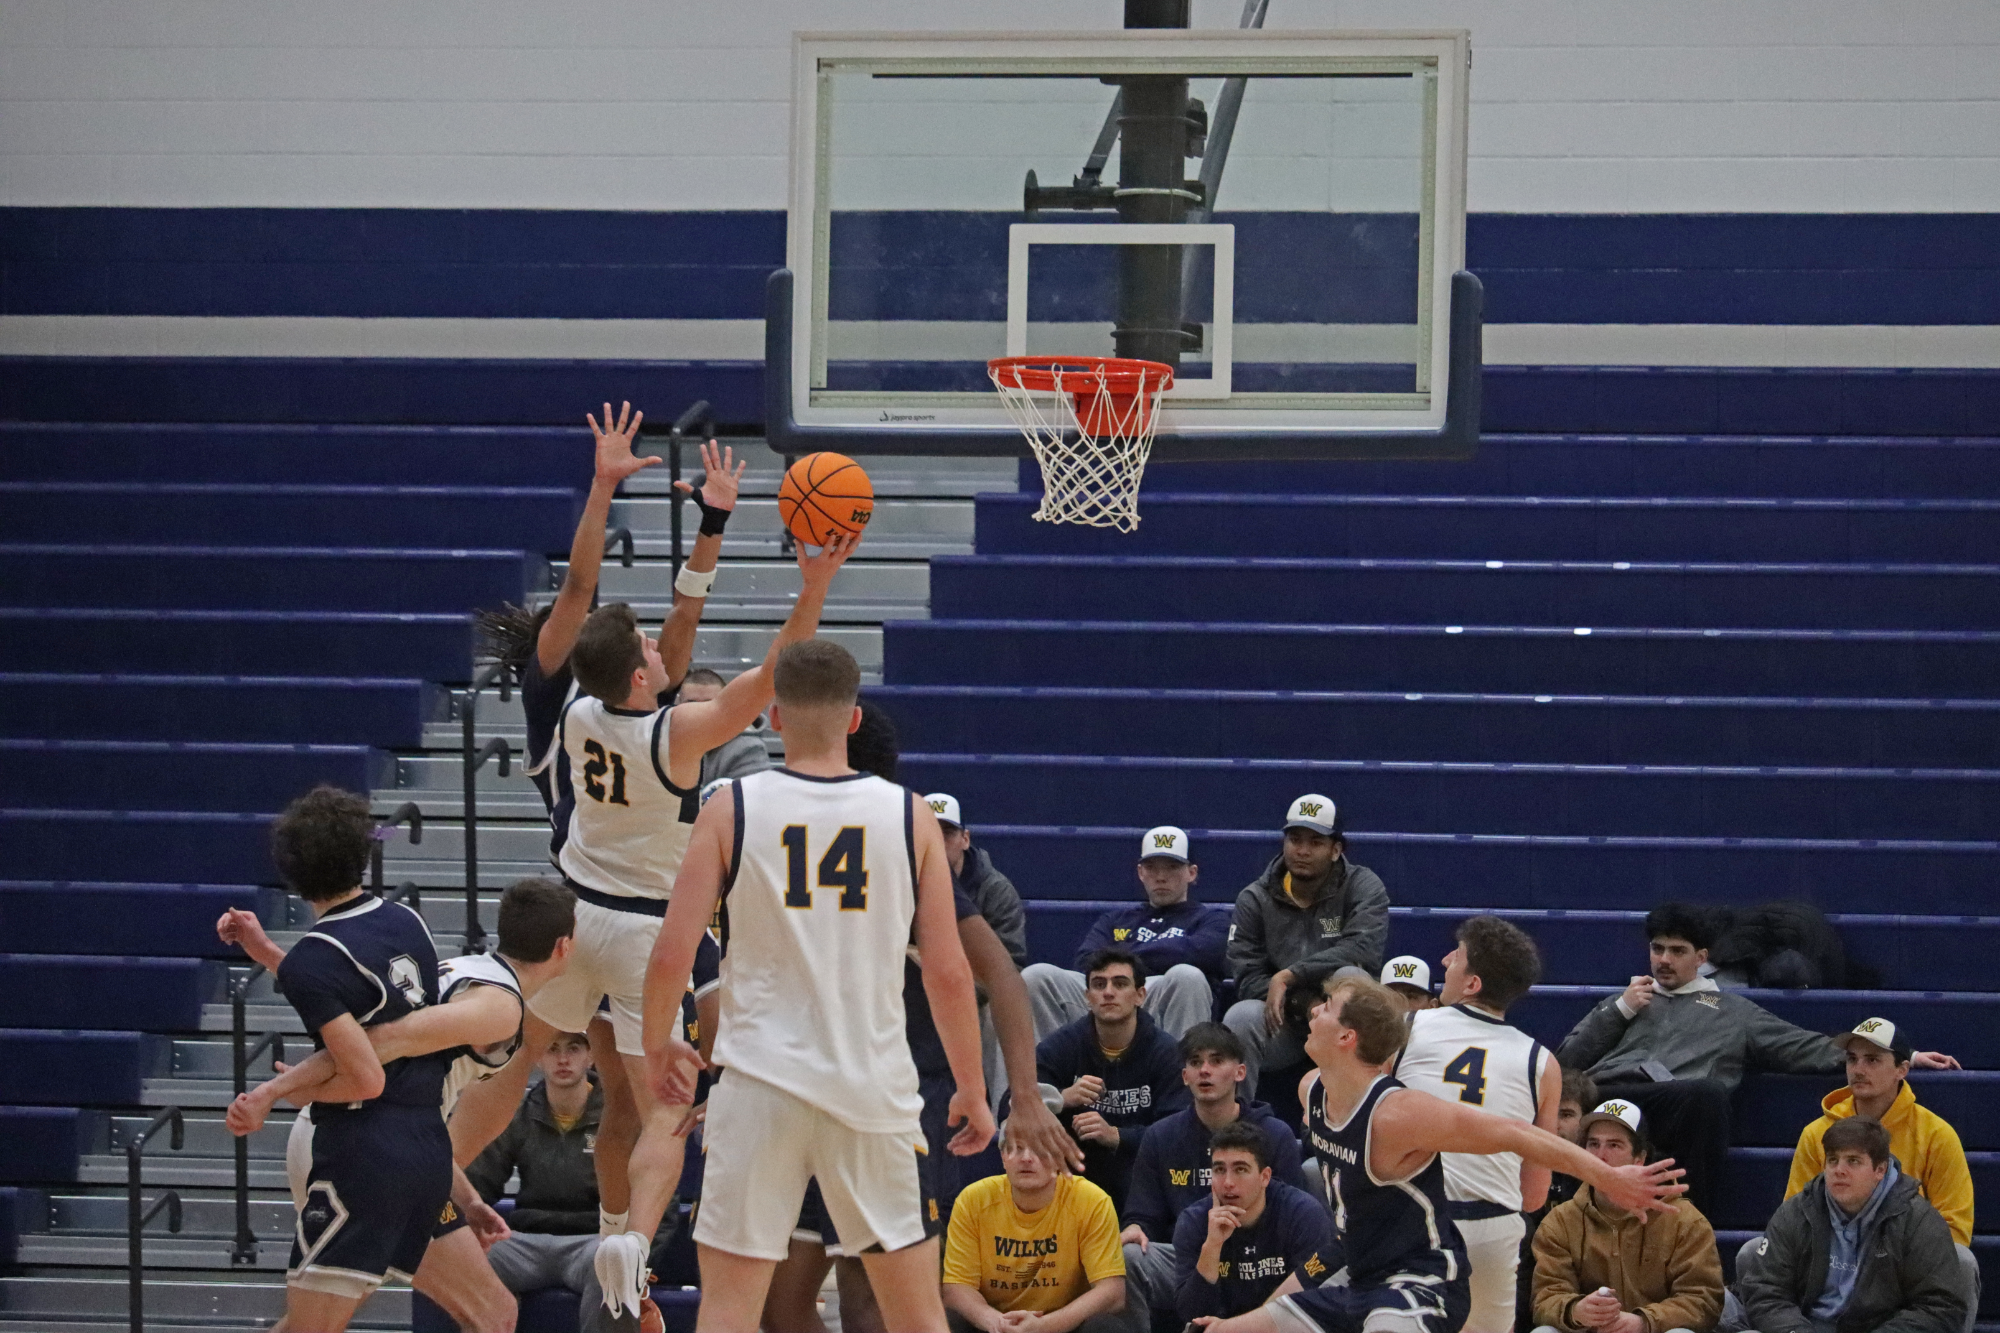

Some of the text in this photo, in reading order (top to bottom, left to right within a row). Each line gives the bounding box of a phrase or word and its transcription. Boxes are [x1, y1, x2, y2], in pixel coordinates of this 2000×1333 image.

[583, 738, 630, 807] 21
[1299, 802, 1323, 817] W
[1153, 834, 1176, 848] W
[781, 823, 870, 912] 14
[1393, 963, 1417, 978] W
[1857, 1020, 1883, 1033] W
[1442, 1046, 1488, 1107] 4
[1603, 1103, 1628, 1116] W
[1311, 1130, 1358, 1165] MORAVIAN
[1169, 1168, 1191, 1186] W
[1757, 1238, 1769, 1256] 3
[990, 1277, 1060, 1290] BASEALL
